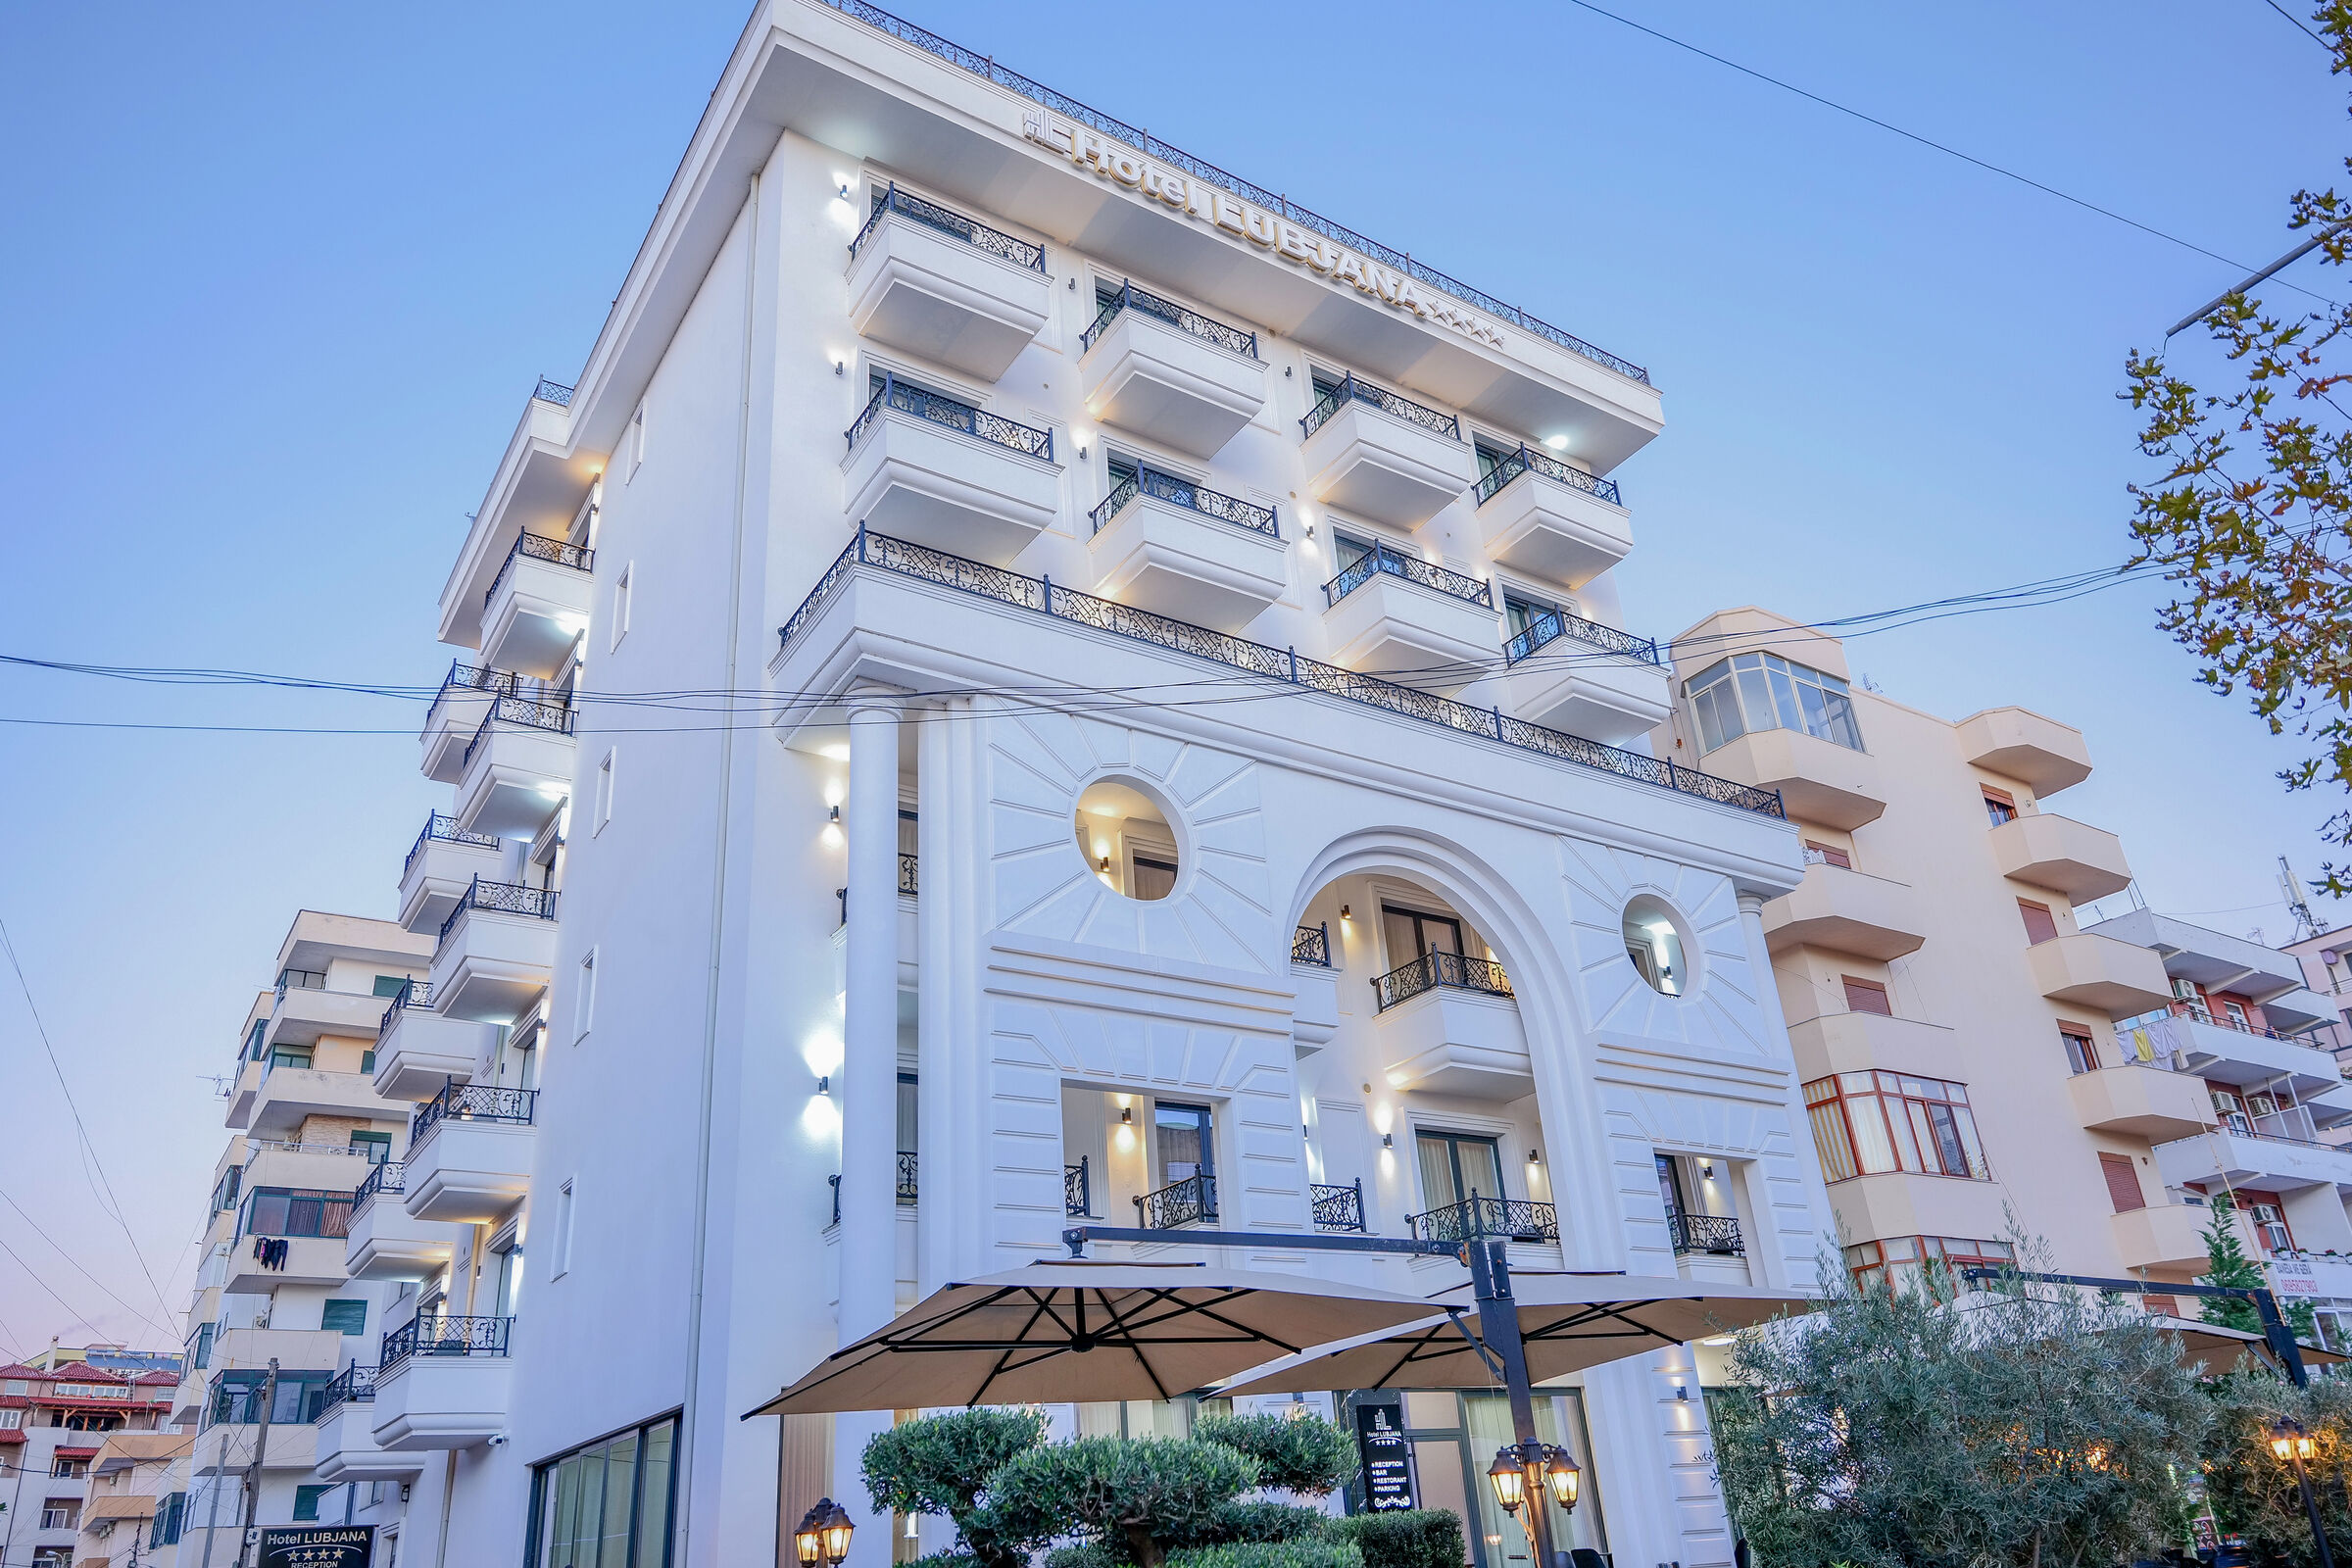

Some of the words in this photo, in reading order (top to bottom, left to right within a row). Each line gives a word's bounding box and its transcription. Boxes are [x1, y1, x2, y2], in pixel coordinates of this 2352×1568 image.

[1071, 127, 1199, 215] Hotel
[1212, 194, 1428, 317] LUBJANA
[267, 1533, 301, 1544] Hotel
[304, 1531, 368, 1544] LUBJANA
